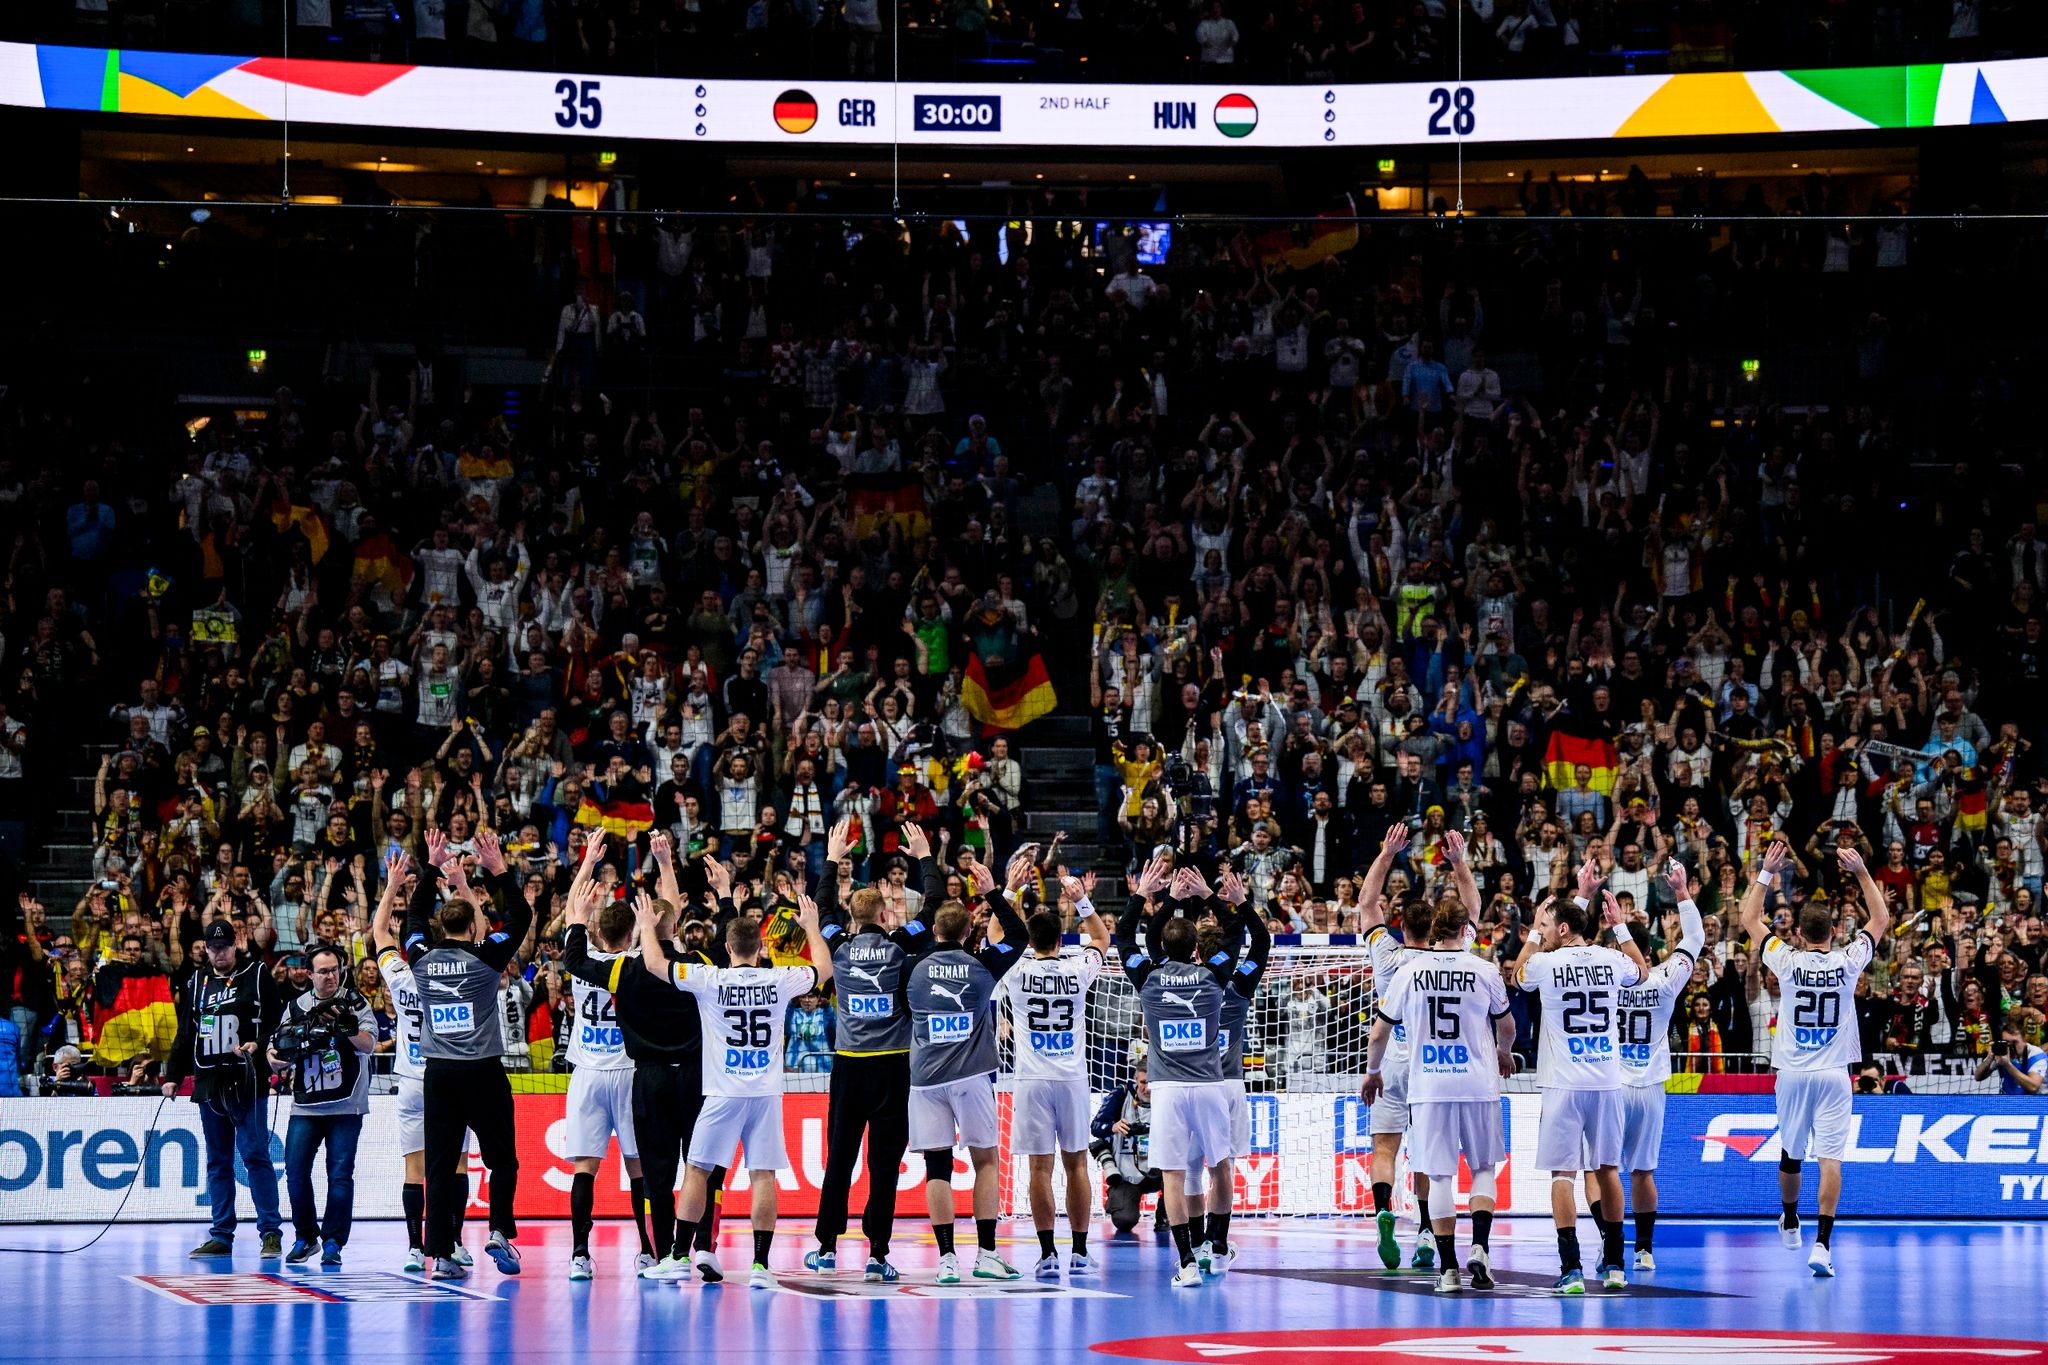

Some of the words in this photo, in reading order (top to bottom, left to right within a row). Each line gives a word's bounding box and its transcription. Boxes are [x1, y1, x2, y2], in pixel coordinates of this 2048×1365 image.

[555, 79, 602, 129] 35
[838, 98, 876, 127] GER
[922, 103, 993, 125] 30:00
[1039, 97, 1070, 110] 2ND
[1074, 97, 1111, 111] HALF
[1428, 86, 1475, 136] 28
[1154, 102, 1196, 129] HUN
[849, 946, 887, 961] GERMANY
[427, 961, 468, 976] GERMANY
[928, 964, 970, 979] GERMANY
[1552, 964, 1615, 988] HÄFNER
[1792, 967, 1846, 988] WEBER
[1021, 973, 1080, 995] USCINS
[1160, 971, 1200, 987] GERMANY
[1413, 970, 1476, 992] KNORR
[717, 985, 778, 1006] MERTENS
[851, 997, 890, 1013] DKB
[433, 1005, 471, 1023] DKB
[1027, 998, 1074, 1031] 23
[1427, 996, 1461, 1040] 15
[1561, 991, 1610, 1034] 25
[1794, 990, 1840, 1028] 20
[724, 1009, 772, 1048] 36
[931, 1016, 970, 1032] DKB
[1163, 1022, 1203, 1039] DKB
[582, 1026, 624, 1045] DKB
[1030, 1032, 1074, 1050] DKB
[1567, 1036, 1613, 1055] DKB
[725, 1049, 771, 1068] DKB
[1422, 1045, 1469, 1064] DKB
[1619, 1044, 1650, 1060] KB
